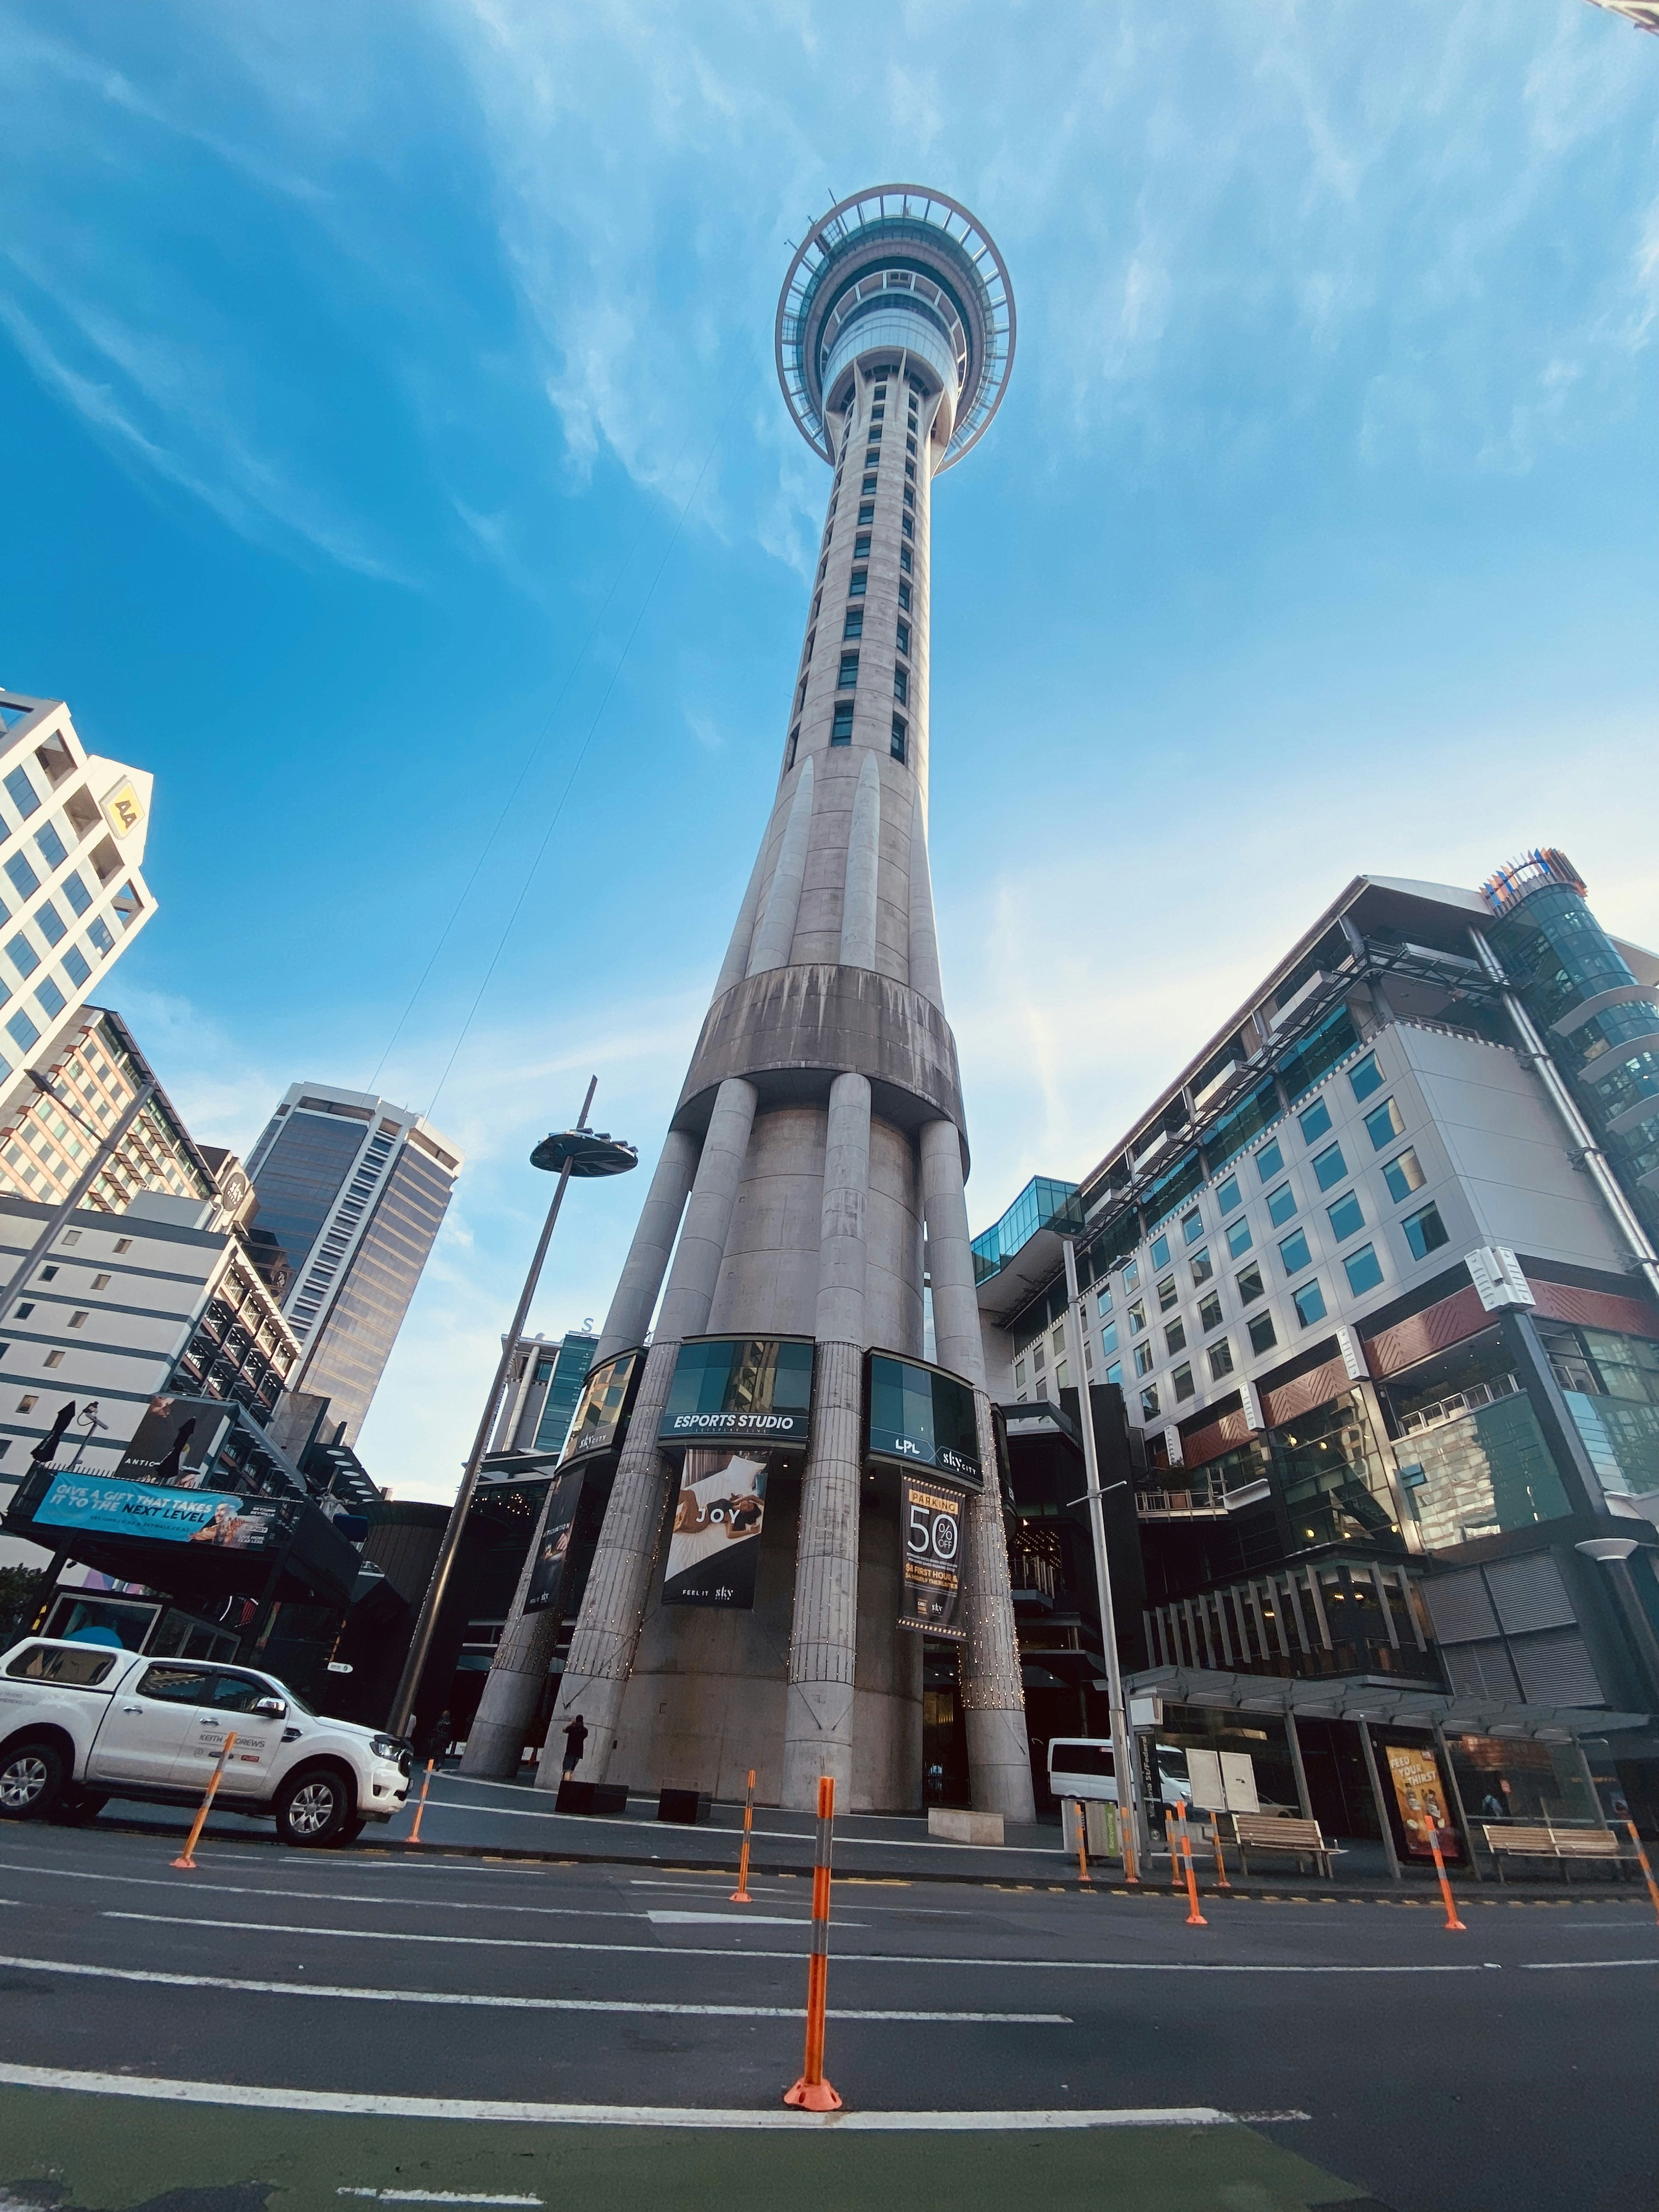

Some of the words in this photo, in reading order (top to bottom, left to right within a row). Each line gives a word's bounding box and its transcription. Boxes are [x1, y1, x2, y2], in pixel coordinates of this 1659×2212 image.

[115, 800, 137, 830] AA
[674, 1415, 736, 1427] ESPORTS
[738, 1415, 794, 1430] STUDIO
[895, 1438, 920, 1454] LPL
[57, 1485, 89, 1496] GIVE
[90, 1489, 100, 1499] A
[103, 1491, 134, 1503] GIFT
[137, 1495, 171, 1508] THAT
[172, 1499, 213, 1513] TAKES
[912, 1493, 955, 1512] PARKING
[49, 1494, 66, 1505] IT
[67, 1497, 88, 1508] TO
[92, 1499, 121, 1512] THE
[121, 1503, 161, 1517] NEXT
[162, 1509, 205, 1523] LEVEL
[696, 1508, 741, 1524] JOY
[907, 1505, 958, 1559] 50
[938, 1539, 952, 1549] OFF
[915, 1566, 932, 1577] FIRST
[933, 1571, 952, 1581] HOUR
[199, 1734, 223, 1742] KEITH
[225, 1736, 266, 1748] DREWS
[1141, 1736, 1151, 1780] St/Federal
[1390, 1756, 1410, 1769] FEED
[1399, 1763, 1422, 1778] YOUR
[1406, 1770, 1436, 1786] THIRST
